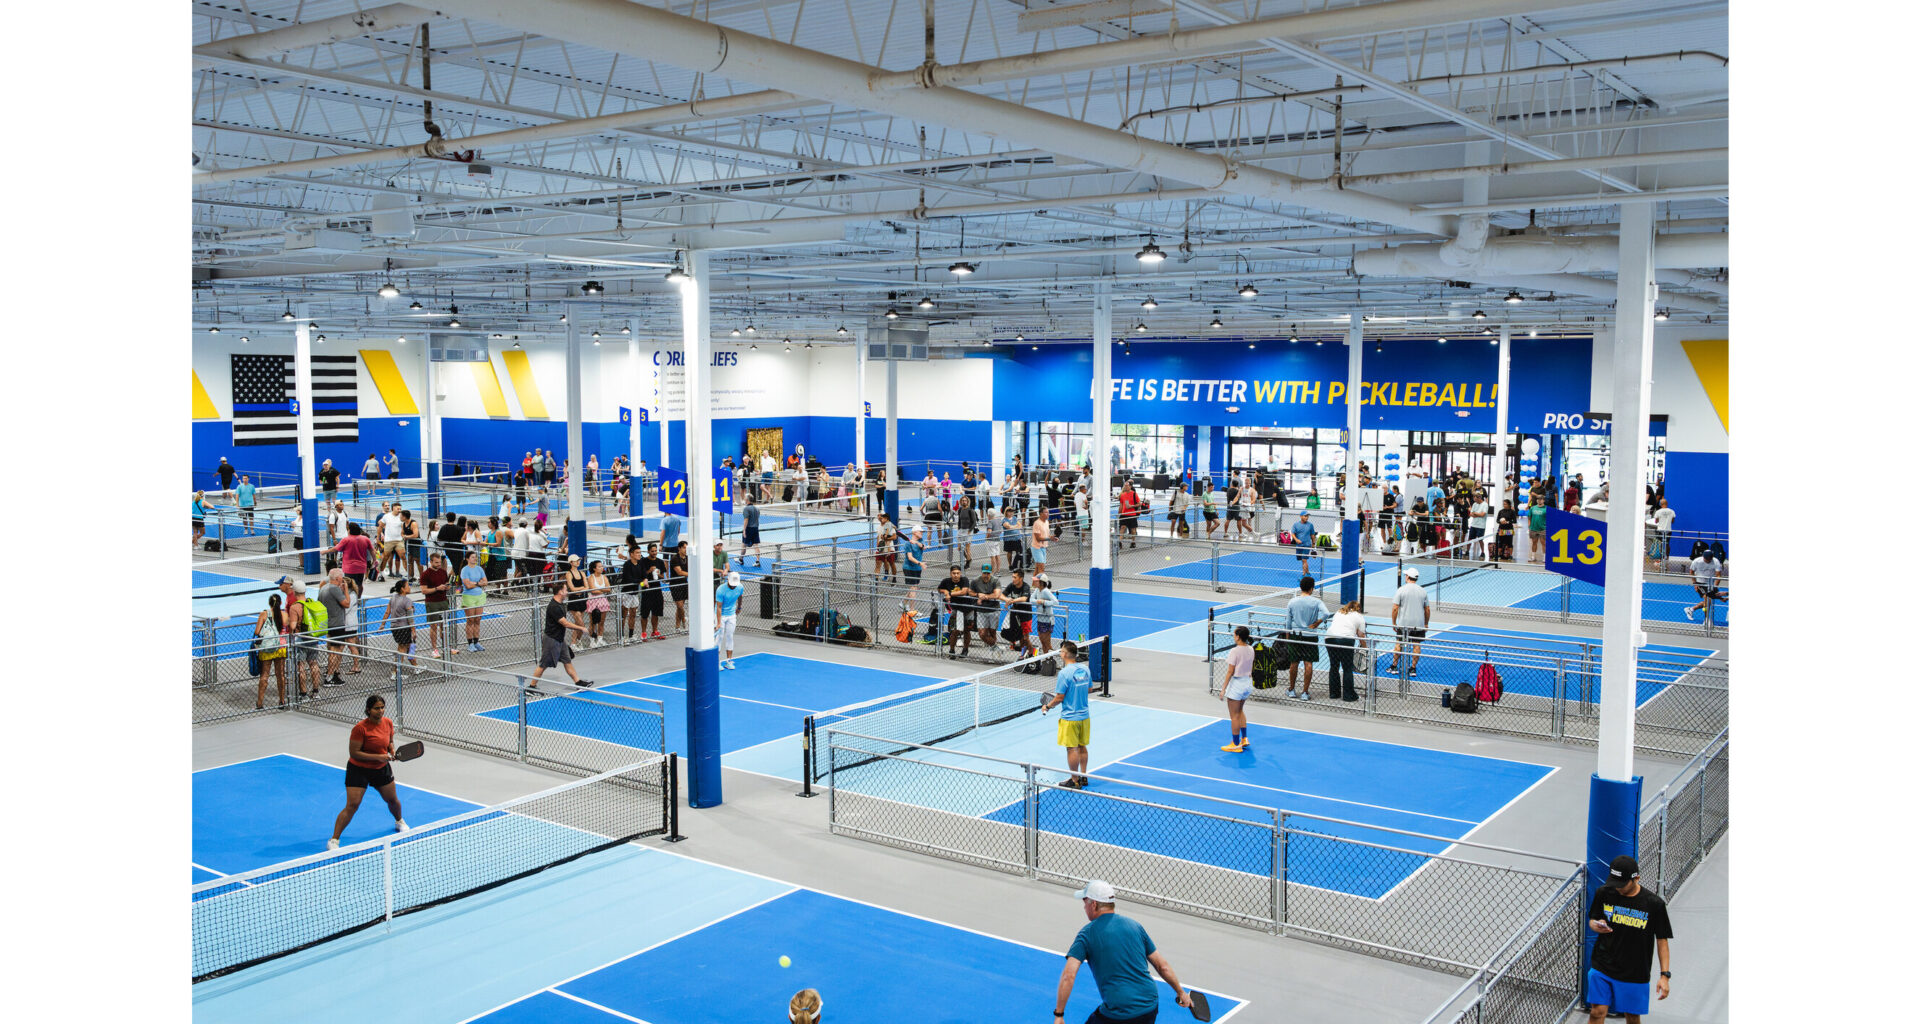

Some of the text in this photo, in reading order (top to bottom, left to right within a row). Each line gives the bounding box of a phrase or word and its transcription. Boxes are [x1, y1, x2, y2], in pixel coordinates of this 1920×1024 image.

[1137, 378, 1158, 402] IS
[1161, 379, 1247, 403] BETTER
[1254, 380, 1320, 404] WITH
[1327, 381, 1498, 408] PCKLEBALL!
[292, 403, 298, 411] 2
[622, 411, 629, 421] 6
[640, 411, 646, 421] 5
[1543, 413, 1584, 430] PRO
[1340, 430, 1348, 443] 10
[661, 479, 686, 505] 12
[1550, 529, 1603, 565] 13
[1612, 914, 1648, 930] KINGDOM
